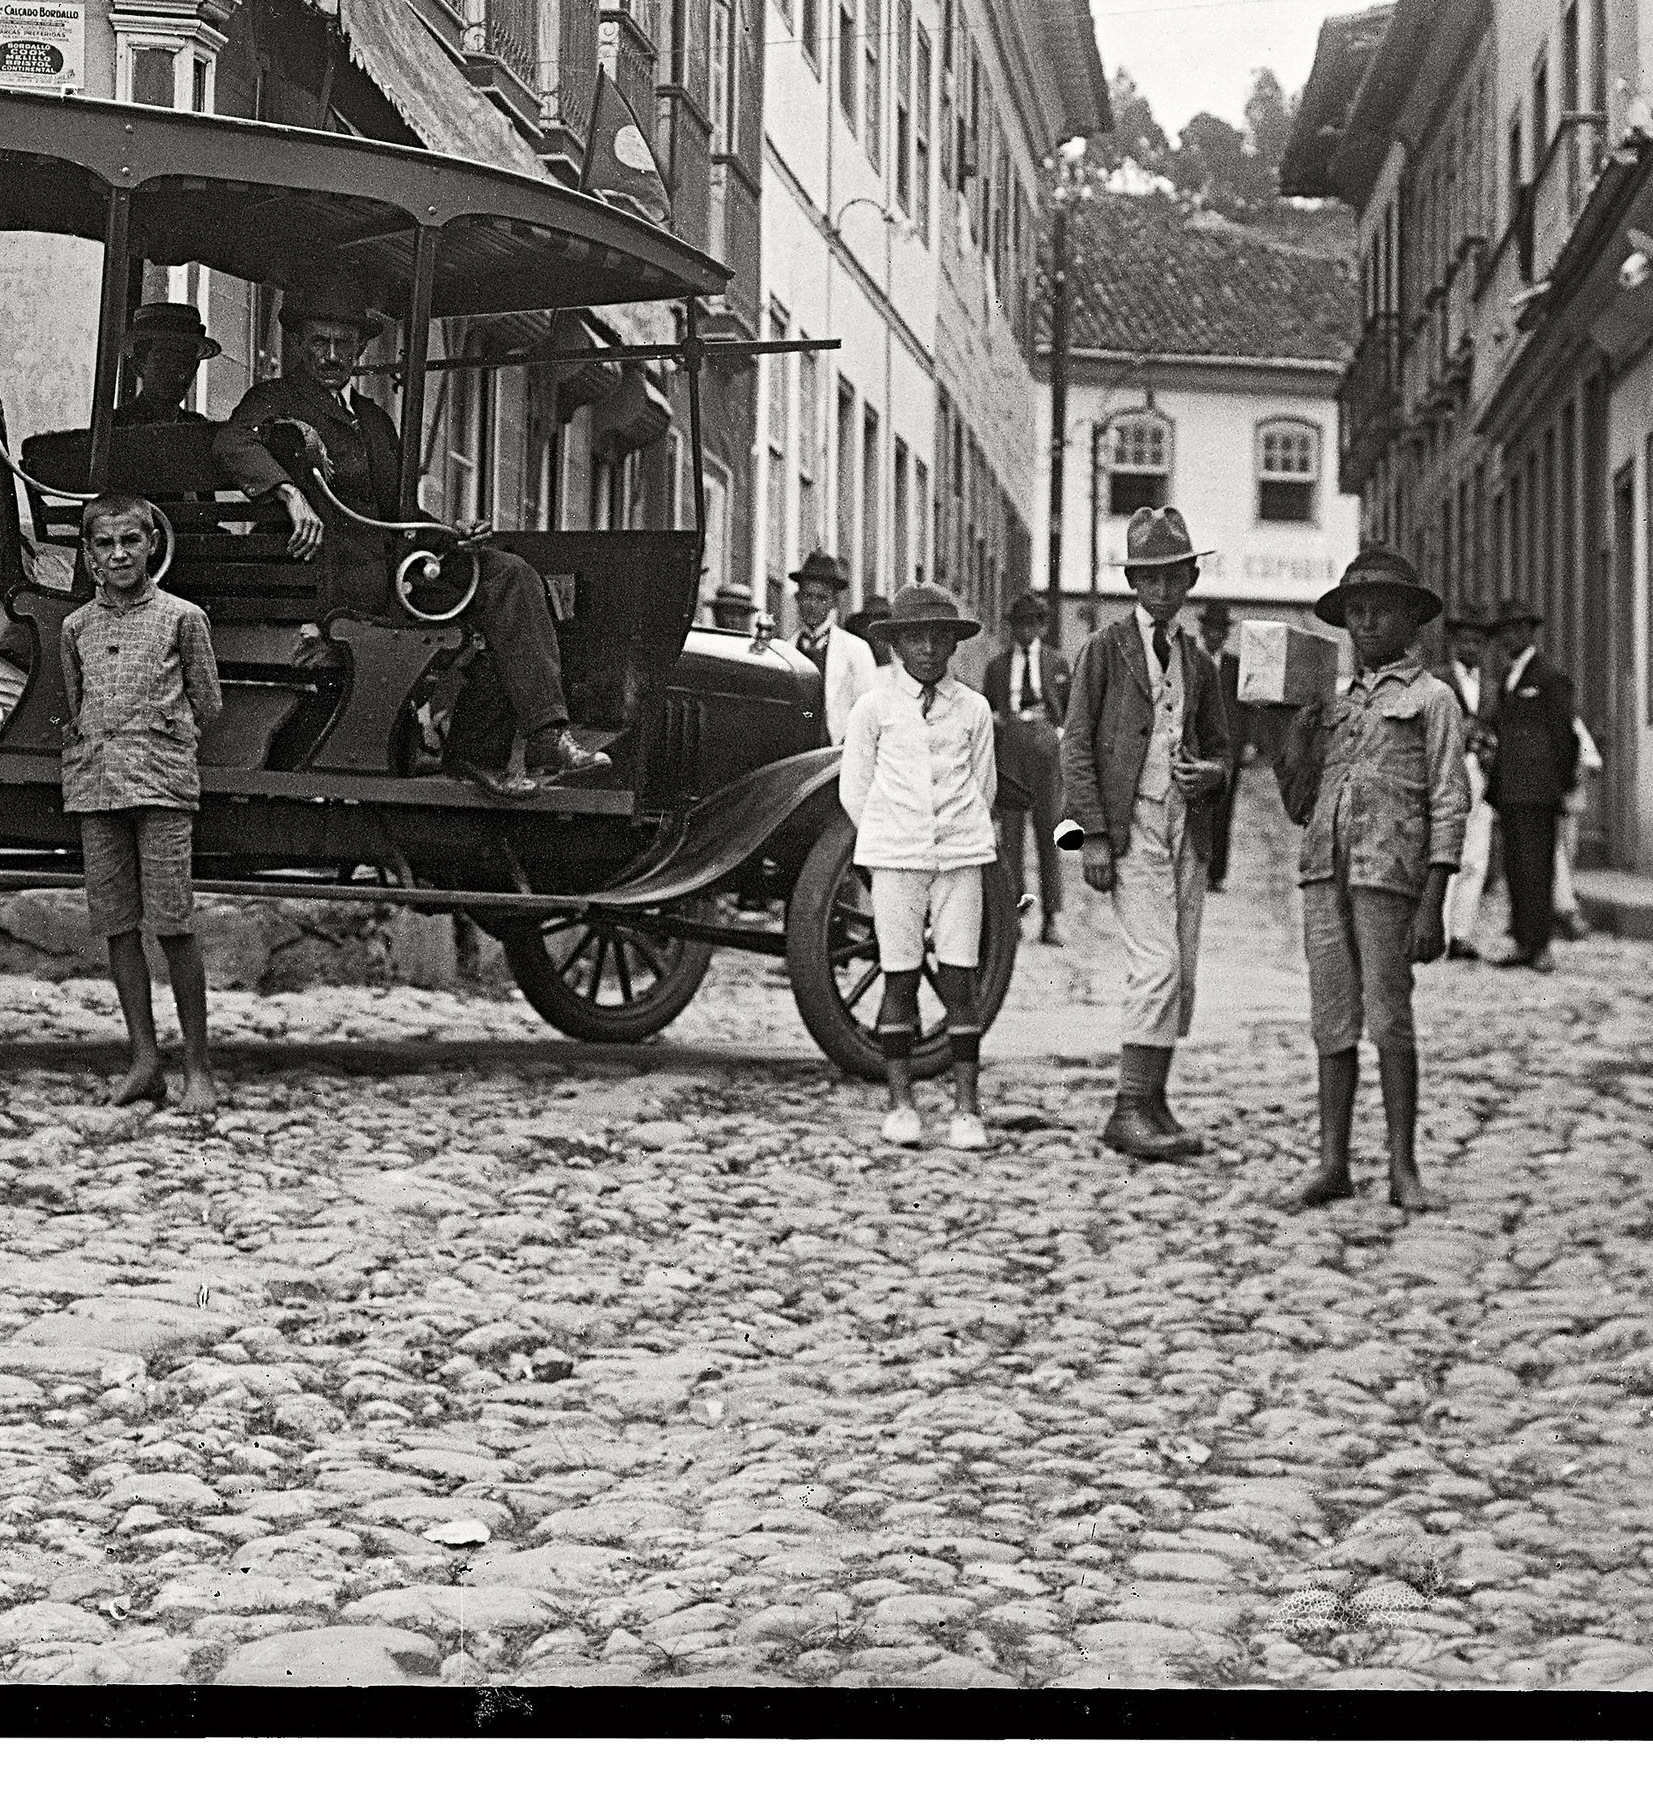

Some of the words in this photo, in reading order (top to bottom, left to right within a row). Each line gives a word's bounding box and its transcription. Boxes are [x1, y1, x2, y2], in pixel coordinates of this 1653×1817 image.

[4, 4, 38, 17] CALÇADO
[39, 6, 79, 20] BORDALLO
[7, 42, 51, 51] BORDALLO
[10, 48, 46, 56] COOK
[5, 54, 51, 62] MELILLO
[5, 60, 52, 68] BRISTOL
[1, 65, 56, 73] CONTINENTAL
